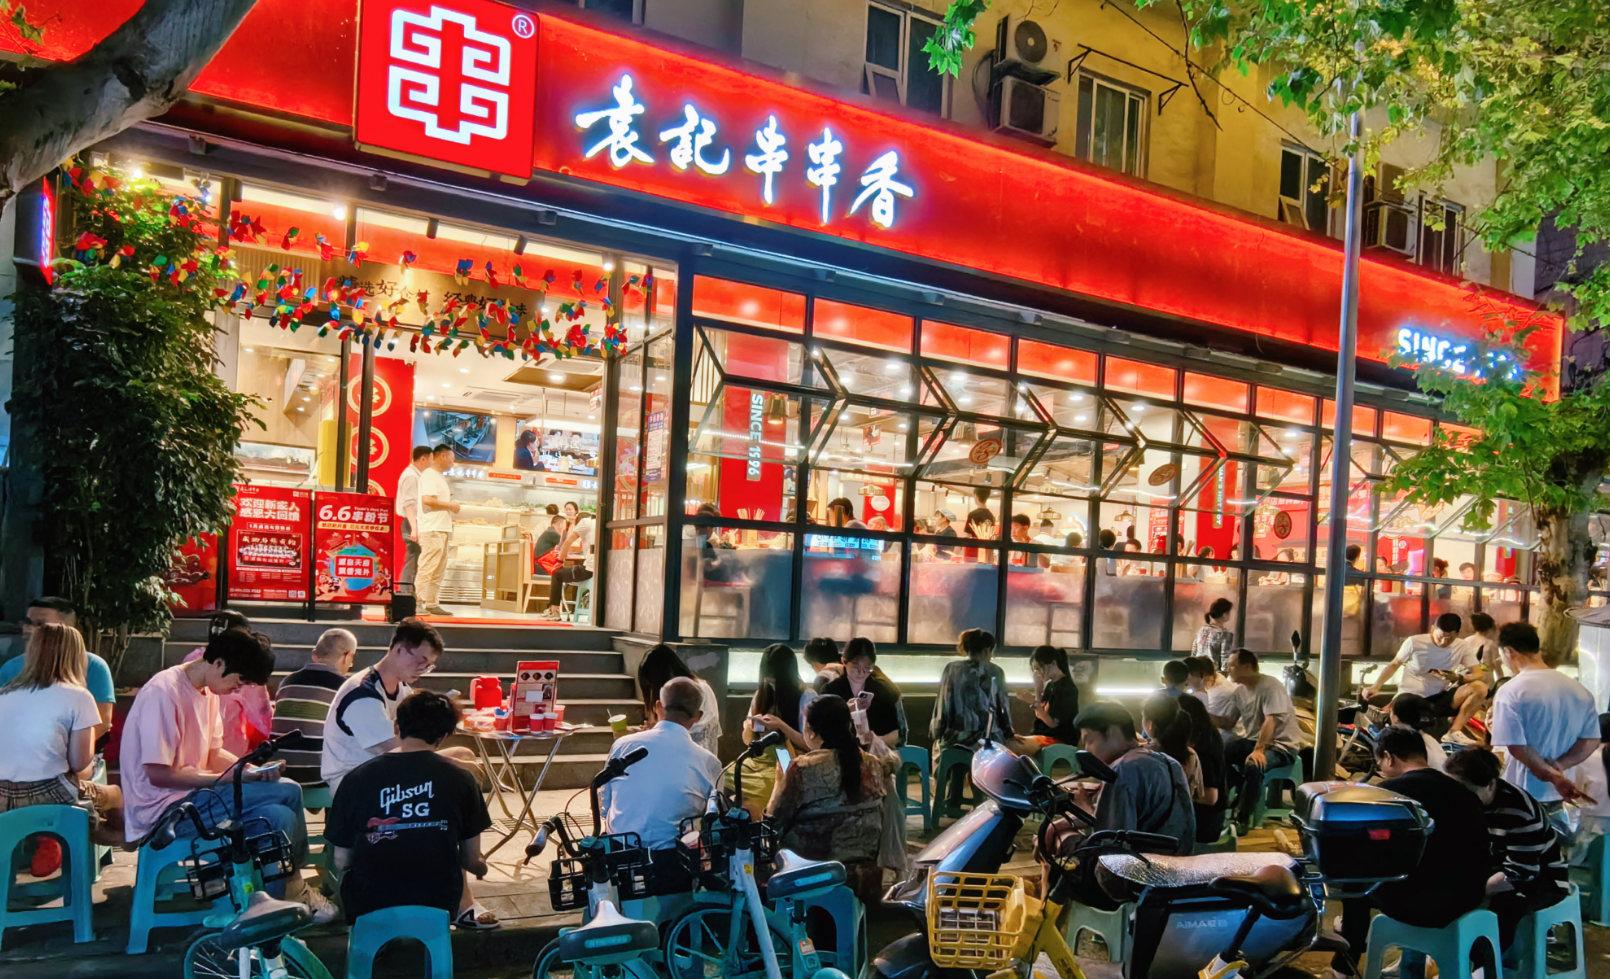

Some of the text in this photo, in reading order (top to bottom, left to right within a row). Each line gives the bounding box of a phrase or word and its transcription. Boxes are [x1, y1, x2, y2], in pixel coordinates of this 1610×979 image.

[575, 73, 915, 229] 袁记串串香
[748, 393, 764, 476] SINCE 1996
[239, 497, 300, 512] 欢迎新家人
[319, 504, 351, 522] 6.6
[239, 507, 300, 522] 感恩大回馈
[380, 780, 435, 816] Gibson
[402, 801, 430, 818] SG
